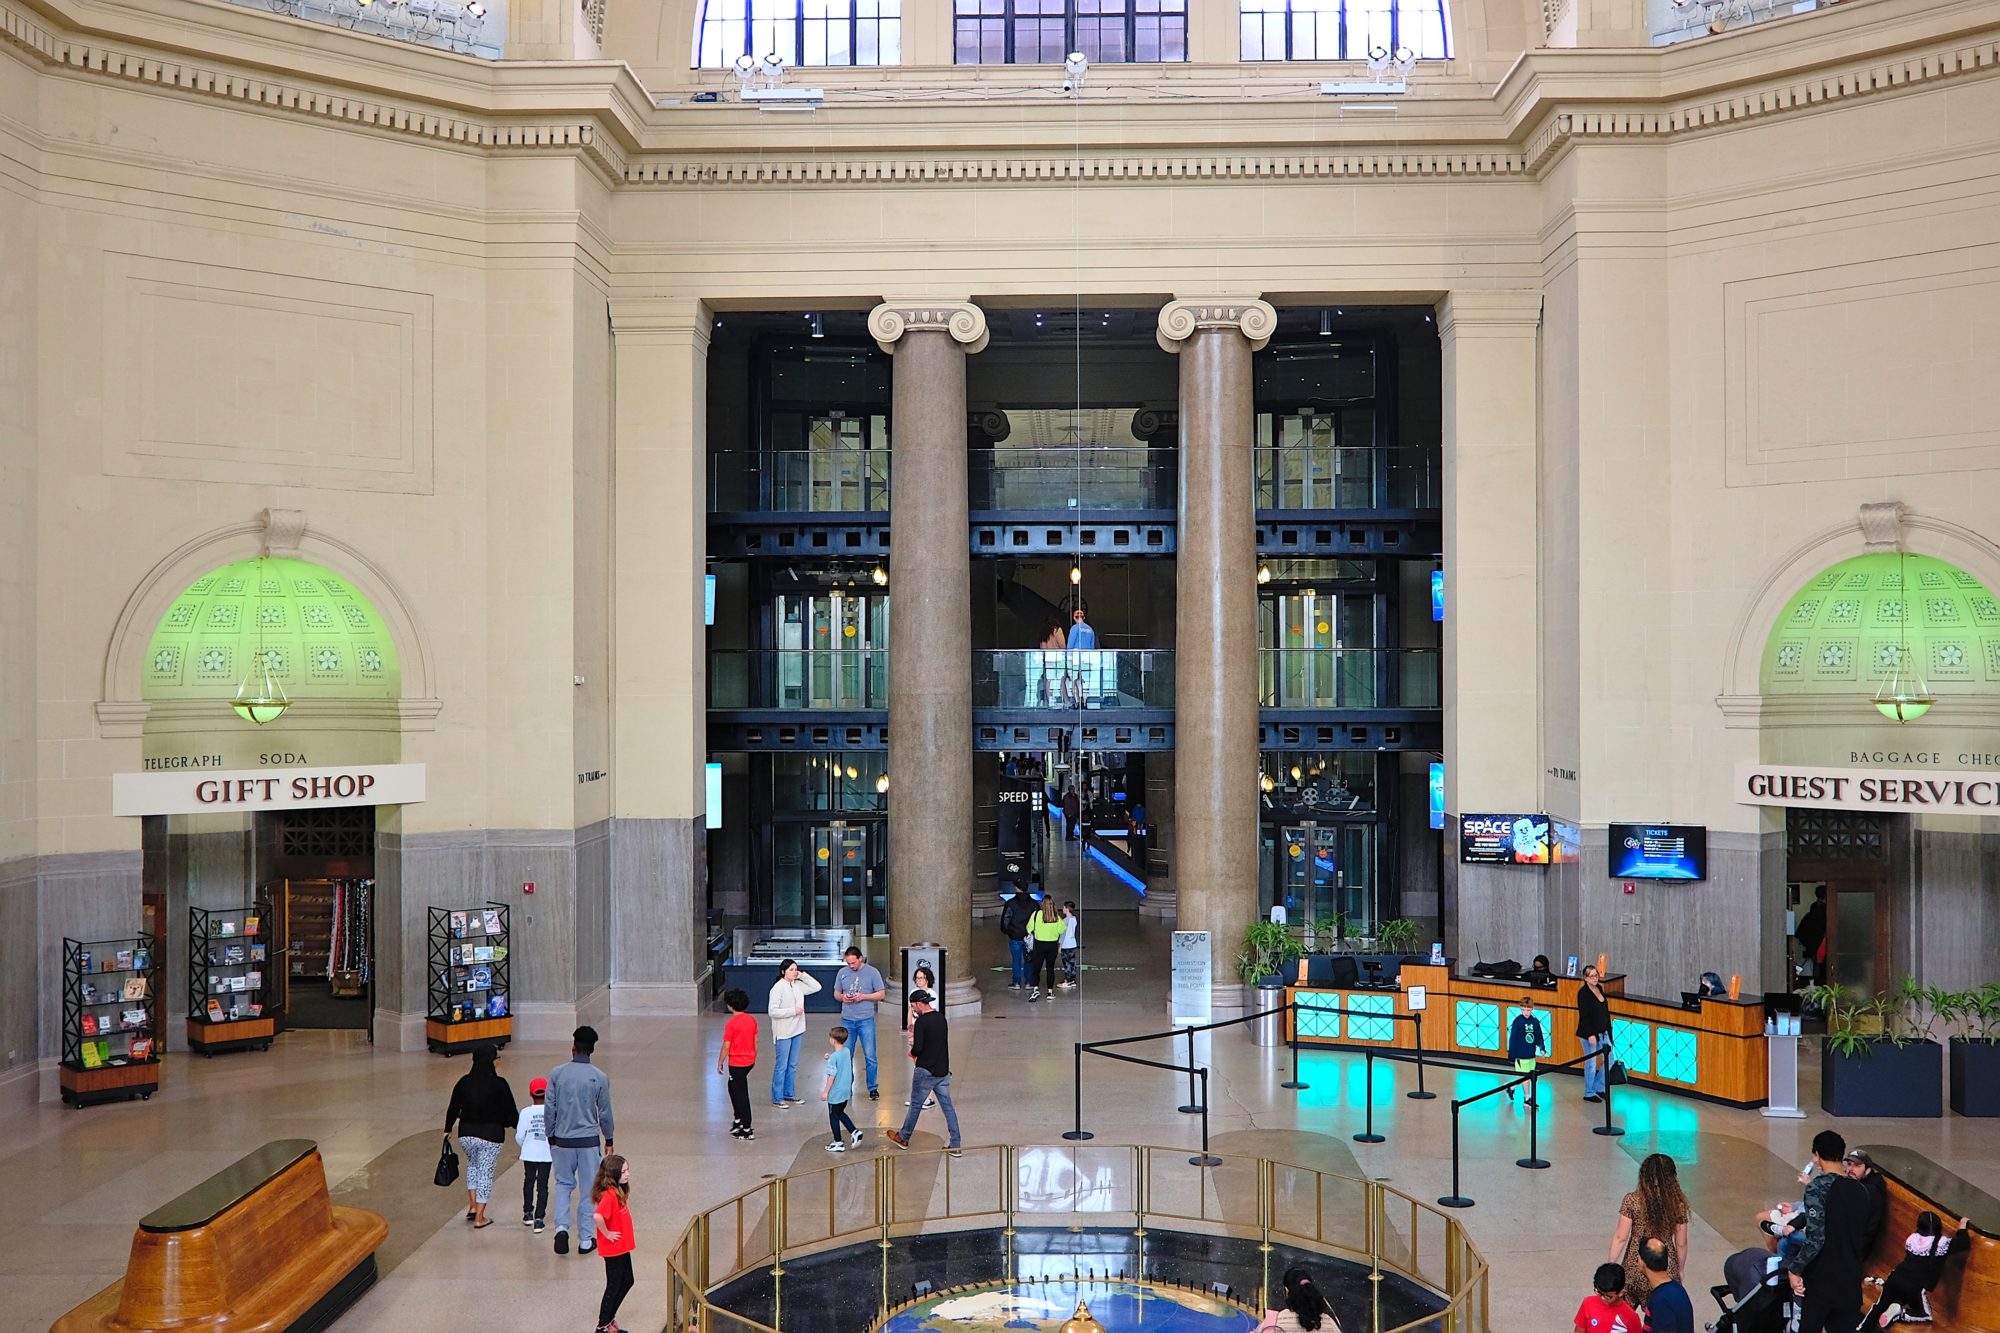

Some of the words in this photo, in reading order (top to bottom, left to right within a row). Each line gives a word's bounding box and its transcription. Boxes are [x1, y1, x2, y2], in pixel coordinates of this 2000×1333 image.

[144, 755, 222, 770] TELEGRAPH
[259, 753, 307, 765] SODA
[1850, 751, 1940, 764] BAGGAGE
[196, 778, 280, 803] GIFT
[291, 774, 375, 800] SHOP
[1748, 774, 1849, 801] GUEST
[999, 792, 1029, 803] SPEED
[1463, 819, 1511, 834] SPACE
